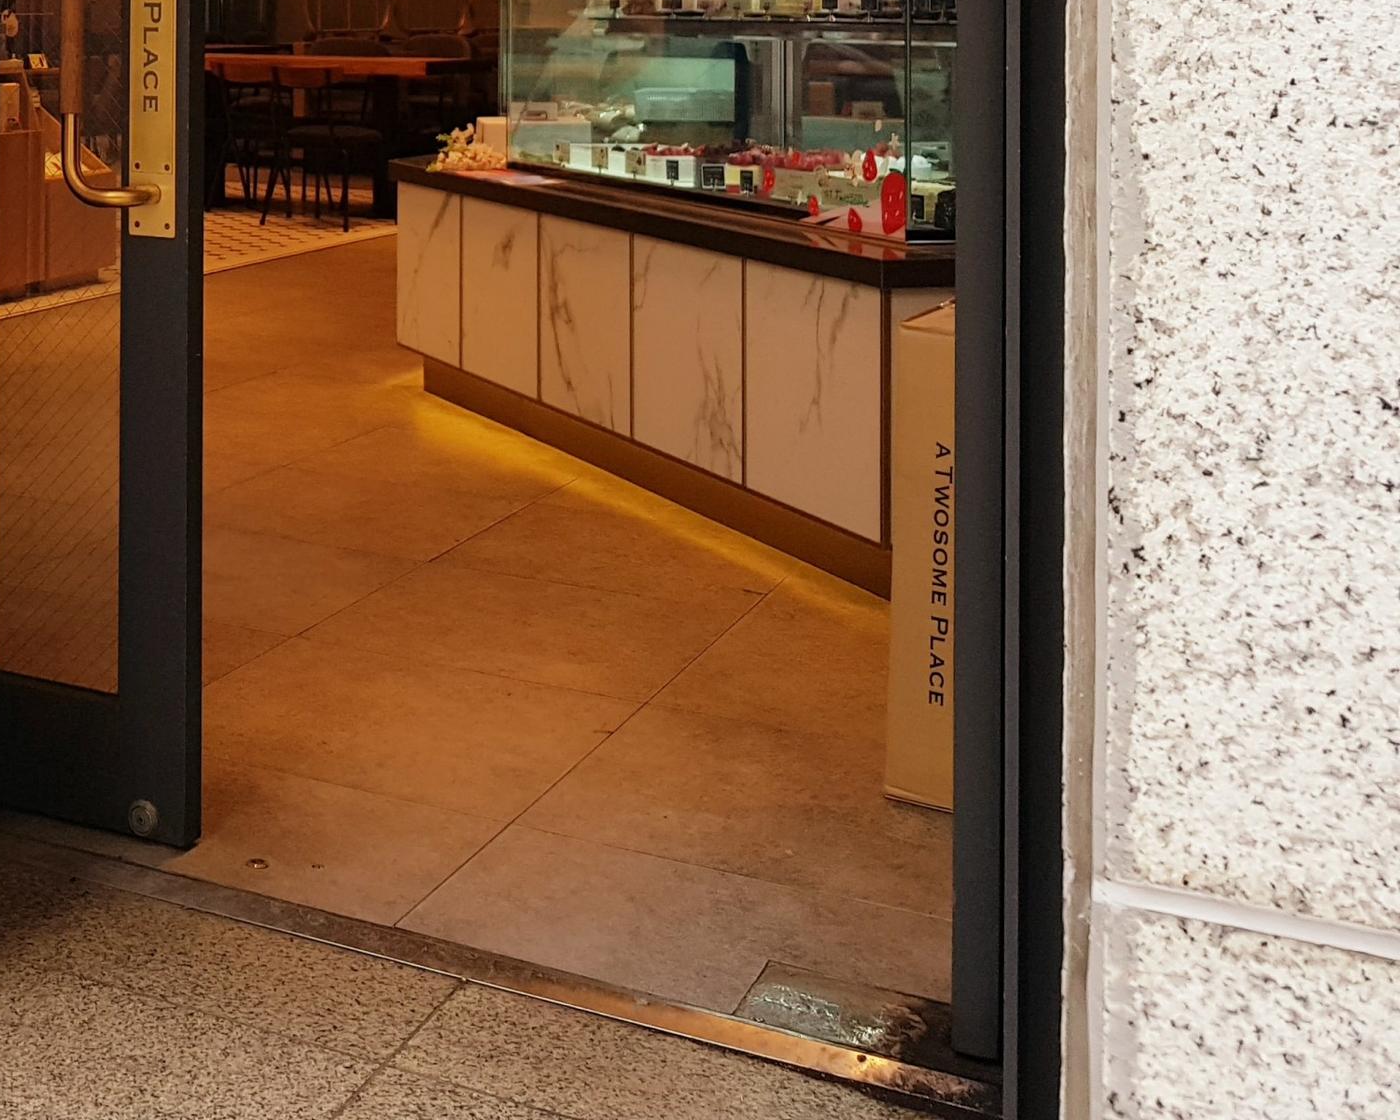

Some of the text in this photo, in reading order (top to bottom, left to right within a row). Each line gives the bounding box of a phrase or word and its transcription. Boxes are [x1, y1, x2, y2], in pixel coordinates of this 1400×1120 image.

[142, 1, 162, 113] PLACE
[928, 441, 953, 707] A TWOSOME PLACE
